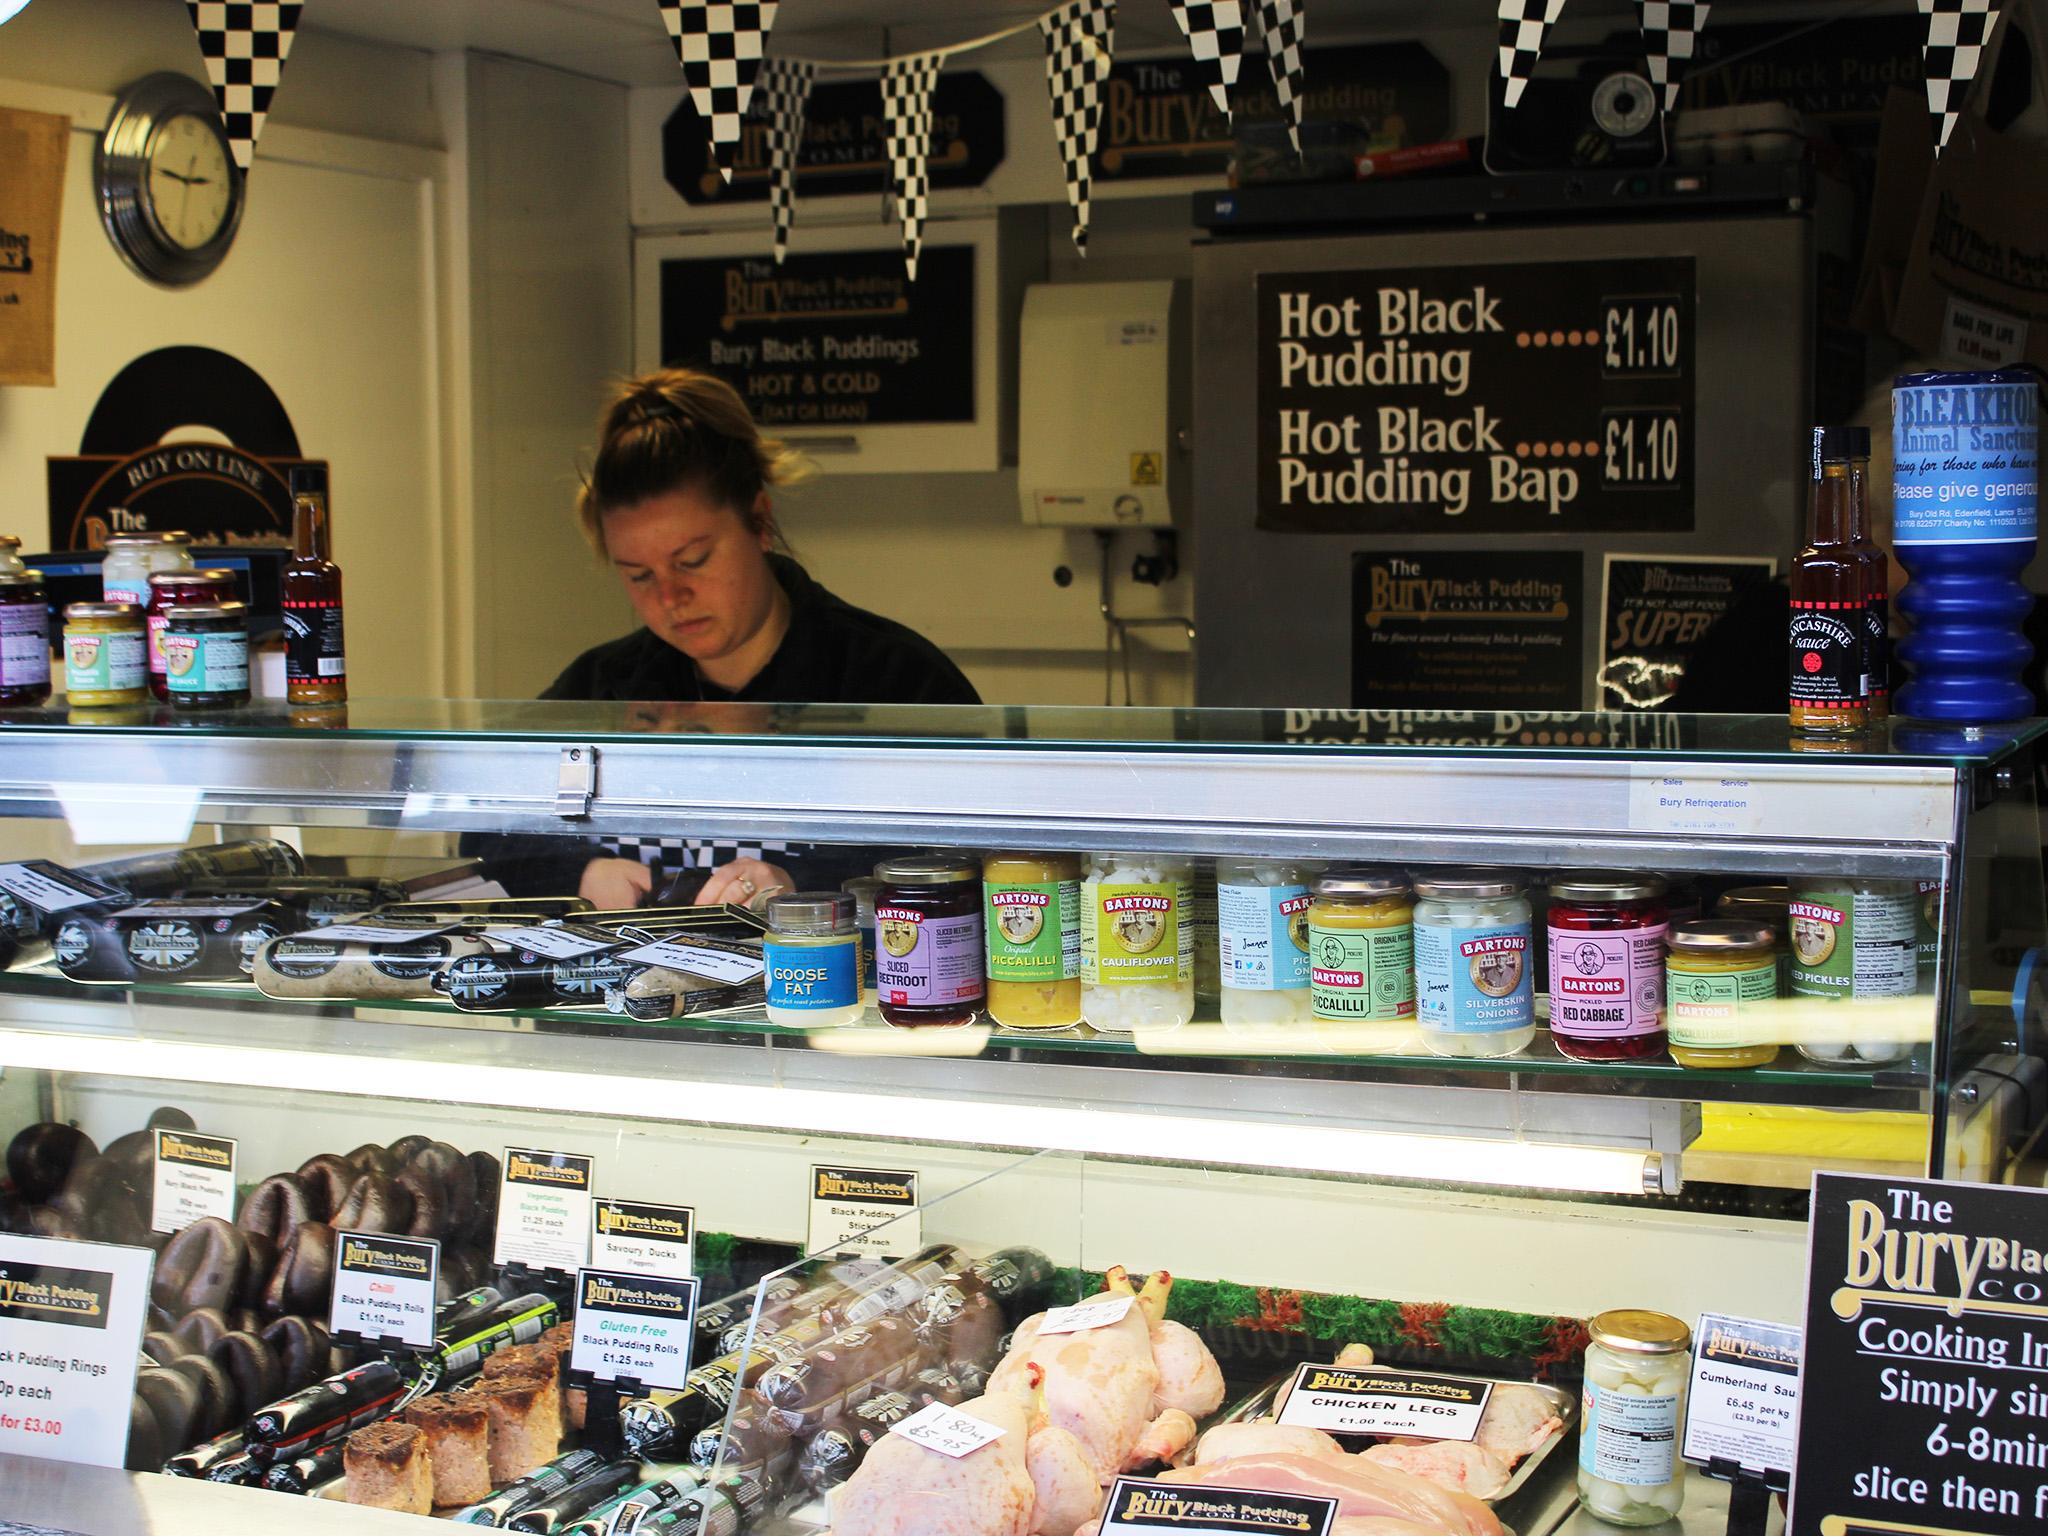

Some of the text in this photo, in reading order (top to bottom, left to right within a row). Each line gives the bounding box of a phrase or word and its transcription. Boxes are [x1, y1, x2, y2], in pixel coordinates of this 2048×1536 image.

[1133, 64, 1183, 91] The
[1108, 78, 1199, 143] Bury
[1278, 285, 1504, 338] Hot Black
[1604, 306, 1679, 369] £1.10
[709, 334, 920, 368] Bury Black Puddings
[1278, 338, 1471, 397] Pudding
[746, 371, 881, 396] HOT & COLD
[1278, 404, 1504, 454] Hot Black
[1604, 417, 1679, 482] £1.10
[1901, 427, 1960, 455] Animal
[126, 448, 264, 488] BUY ON LINE
[1919, 457, 1938, 477] for
[1943, 455, 1977, 472] those
[1981, 454, 2007, 470] who
[1278, 454, 1580, 514] Pudding Bap
[1938, 481, 1979, 503] give
[106, 505, 148, 531] The
[1943, 519, 1972, 529] Charity
[1389, 557, 1421, 579] The
[1370, 565, 1564, 614] Bury Black Pudding
[1434, 600, 1552, 611] COMPANY
[1611, 609, 1714, 651] SUPER
[1790, 620, 1853, 649] ANCASHIRE
[1794, 637, 1831, 650] sauce
[1663, 778, 1749, 788] Sales Service
[1659, 797, 1747, 810] Bury Refrigeration
[992, 893, 1047, 905] BARTONS
[1104, 897, 1169, 912] BARTONS
[877, 909, 922, 923] BARTONS
[1790, 903, 1843, 924] BARTONS
[1003, 941, 1037, 958] Original
[1463, 938, 1526, 955] BARTONS
[729, 959, 757, 970] Rolls
[886, 960, 910, 973] SLICED
[991, 954, 1057, 968] PICCALILLI
[1101, 956, 1175, 968] CAULIFLOWER
[774, 967, 829, 982] GOOSE
[878, 974, 929, 989] BEETROOT
[1311, 970, 1361, 985] BARTONS
[1804, 971, 1851, 988] PICKLES
[785, 982, 815, 996] FAT
[1321, 988, 1345, 996] ORIGINAL
[1563, 979, 1621, 993] BARTONS
[1312, 995, 1364, 1012] PICCALILLI
[1465, 995, 1526, 1009] SILVERSKIN
[1676, 1004, 1730, 1018] BARTONS
[1475, 1007, 1520, 1019] ONIONS
[1562, 1006, 1625, 1022] RED CABBAGE
[819, 1173, 850, 1194] Bury
[827, 1171, 843, 1181] The
[848, 1188, 902, 1196] COMPANY
[831, 1207, 896, 1220] Black Pudding
[1887, 1188, 1954, 1224] The
[599, 1207, 630, 1229] Bury
[345, 1242, 376, 1264] Bury
[606, 1243, 677, 1259] Savoury Ducks
[871, 1239, 891, 1248] each
[1844, 1199, 1990, 1318] Bury
[18, 1281, 100, 1304] Black Pudding
[588, 1279, 683, 1306] Bury Black Pudding
[596, 1278, 614, 1288] The
[1978, 1279, 2043, 1301] CO
[15, 1293, 91, 1310] COMPANY
[342, 1294, 425, 1314] Black Pudding Rolls
[618, 1297, 676, 1308] COMPANY
[360, 1311, 385, 1324] £1.10
[599, 1320, 668, 1338] Gluten Free
[1722, 1325, 1741, 1338] The
[582, 1334, 680, 1356] Black Pudding Rolls
[1710, 1328, 1752, 1356] Bury
[1858, 1315, 2048, 1370] Cooking In
[18, 1351, 68, 1373] Pudding
[69, 1357, 108, 1378] Rings
[602, 1353, 655, 1369] £1.25 each
[1746, 1349, 1795, 1365] COMPA
[1312, 1371, 1471, 1396] Bury Pudding
[1330, 1371, 1358, 1380] The
[1699, 1370, 1768, 1394] Cumberland
[18, 1382, 53, 1402] each
[1880, 1367, 2048, 1418] Simply si
[1311, 1397, 1459, 1417] CHICKEN LEGS
[1726, 1396, 1790, 1420] £6.45 per kg
[1, 1413, 63, 1436] for £3.00
[1339, 1417, 1416, 1429] £1.00 each
[1926, 1423, 2048, 1469] 6-8mi
[1149, 1489, 1178, 1501] The
[1852, 1465, 2048, 1519] slice then f
[1124, 1490, 1310, 1523] Bury Black Pudding
[1189, 1511, 1300, 1526] COMPANY
